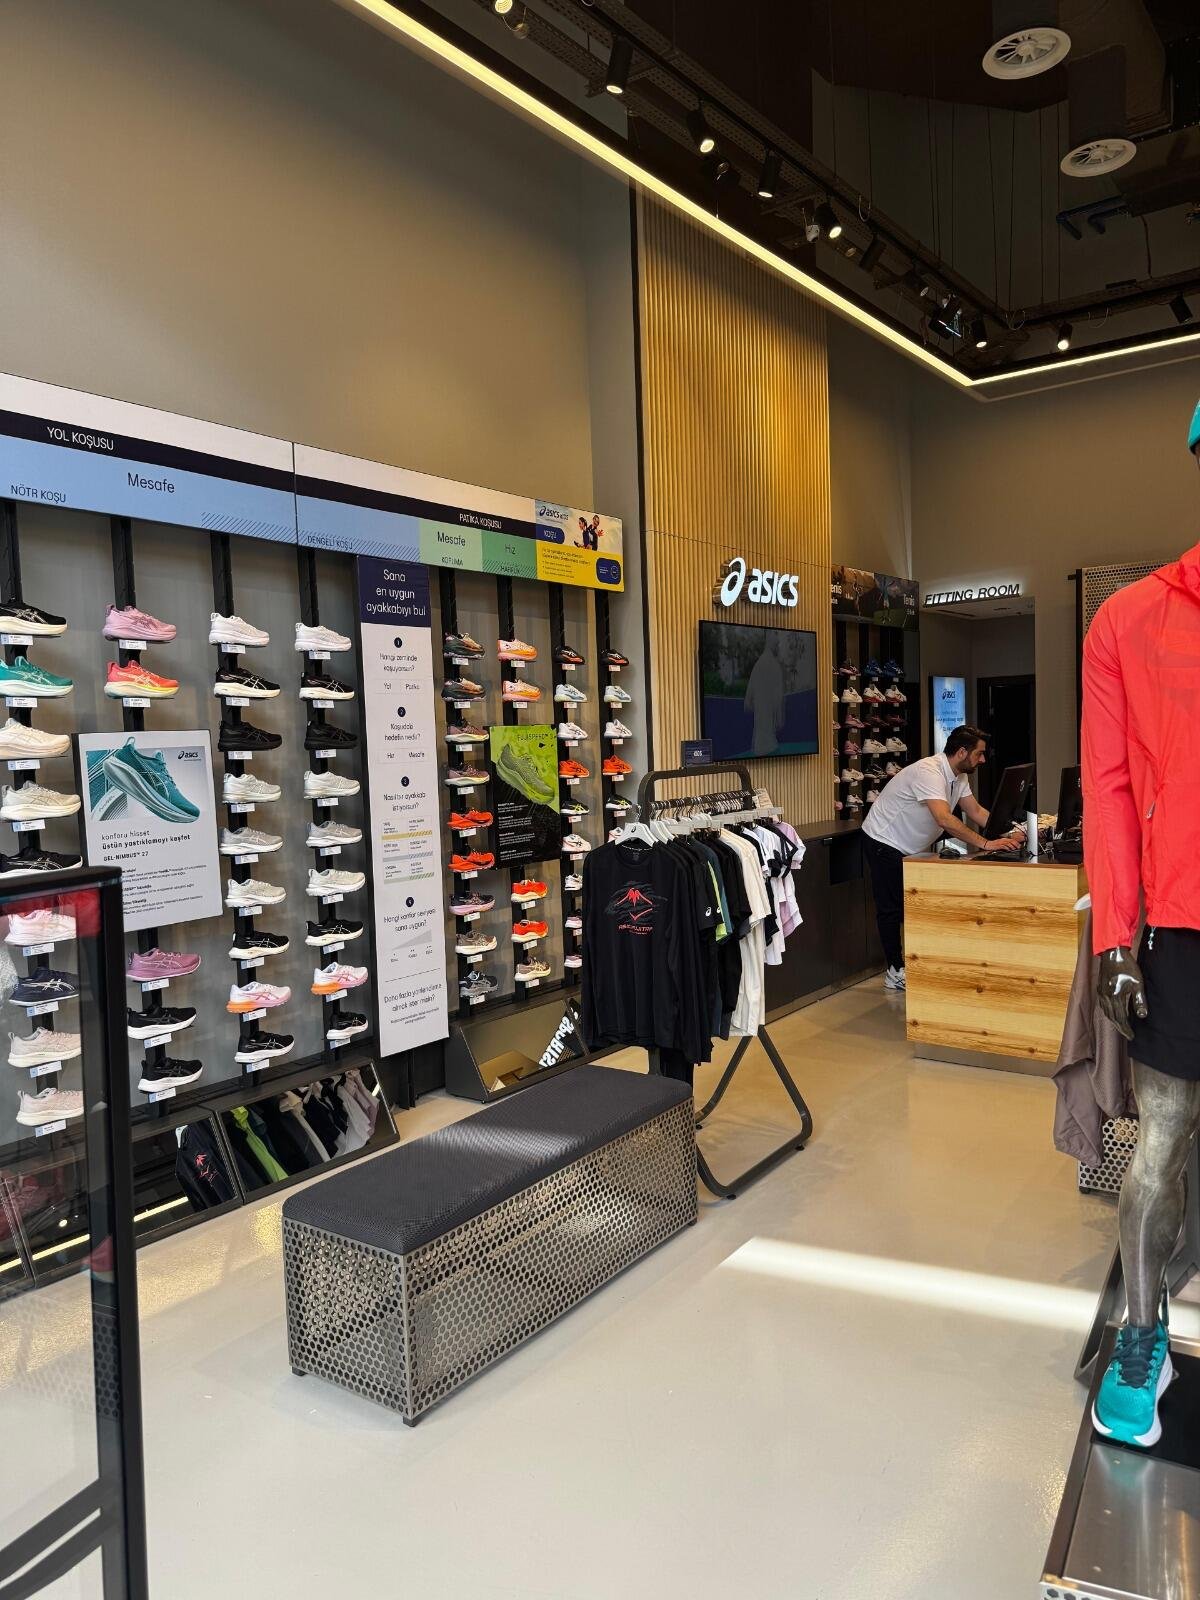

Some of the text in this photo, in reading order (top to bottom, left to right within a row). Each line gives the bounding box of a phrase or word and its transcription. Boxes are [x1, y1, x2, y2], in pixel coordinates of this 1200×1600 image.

[47, 426, 114, 450] YOL KOŞUSU
[128, 472, 175, 493] Mesafe
[11, 483, 66, 504] NÖTR KOŞU
[480, 518, 502, 529] KOŞUSU
[437, 531, 466, 546] Mesafe
[383, 569, 406, 582] Sana
[376, 587, 415, 600] en uygun
[748, 568, 799, 607] asics
[925, 584, 1020, 605] FITTING ROOM
[366, 602, 426, 617] ayakkabıyı bul
[101, 832, 128, 840] konforu
[102, 842, 122, 850] üstün
[124, 838, 168, 848] yastıklamayı
